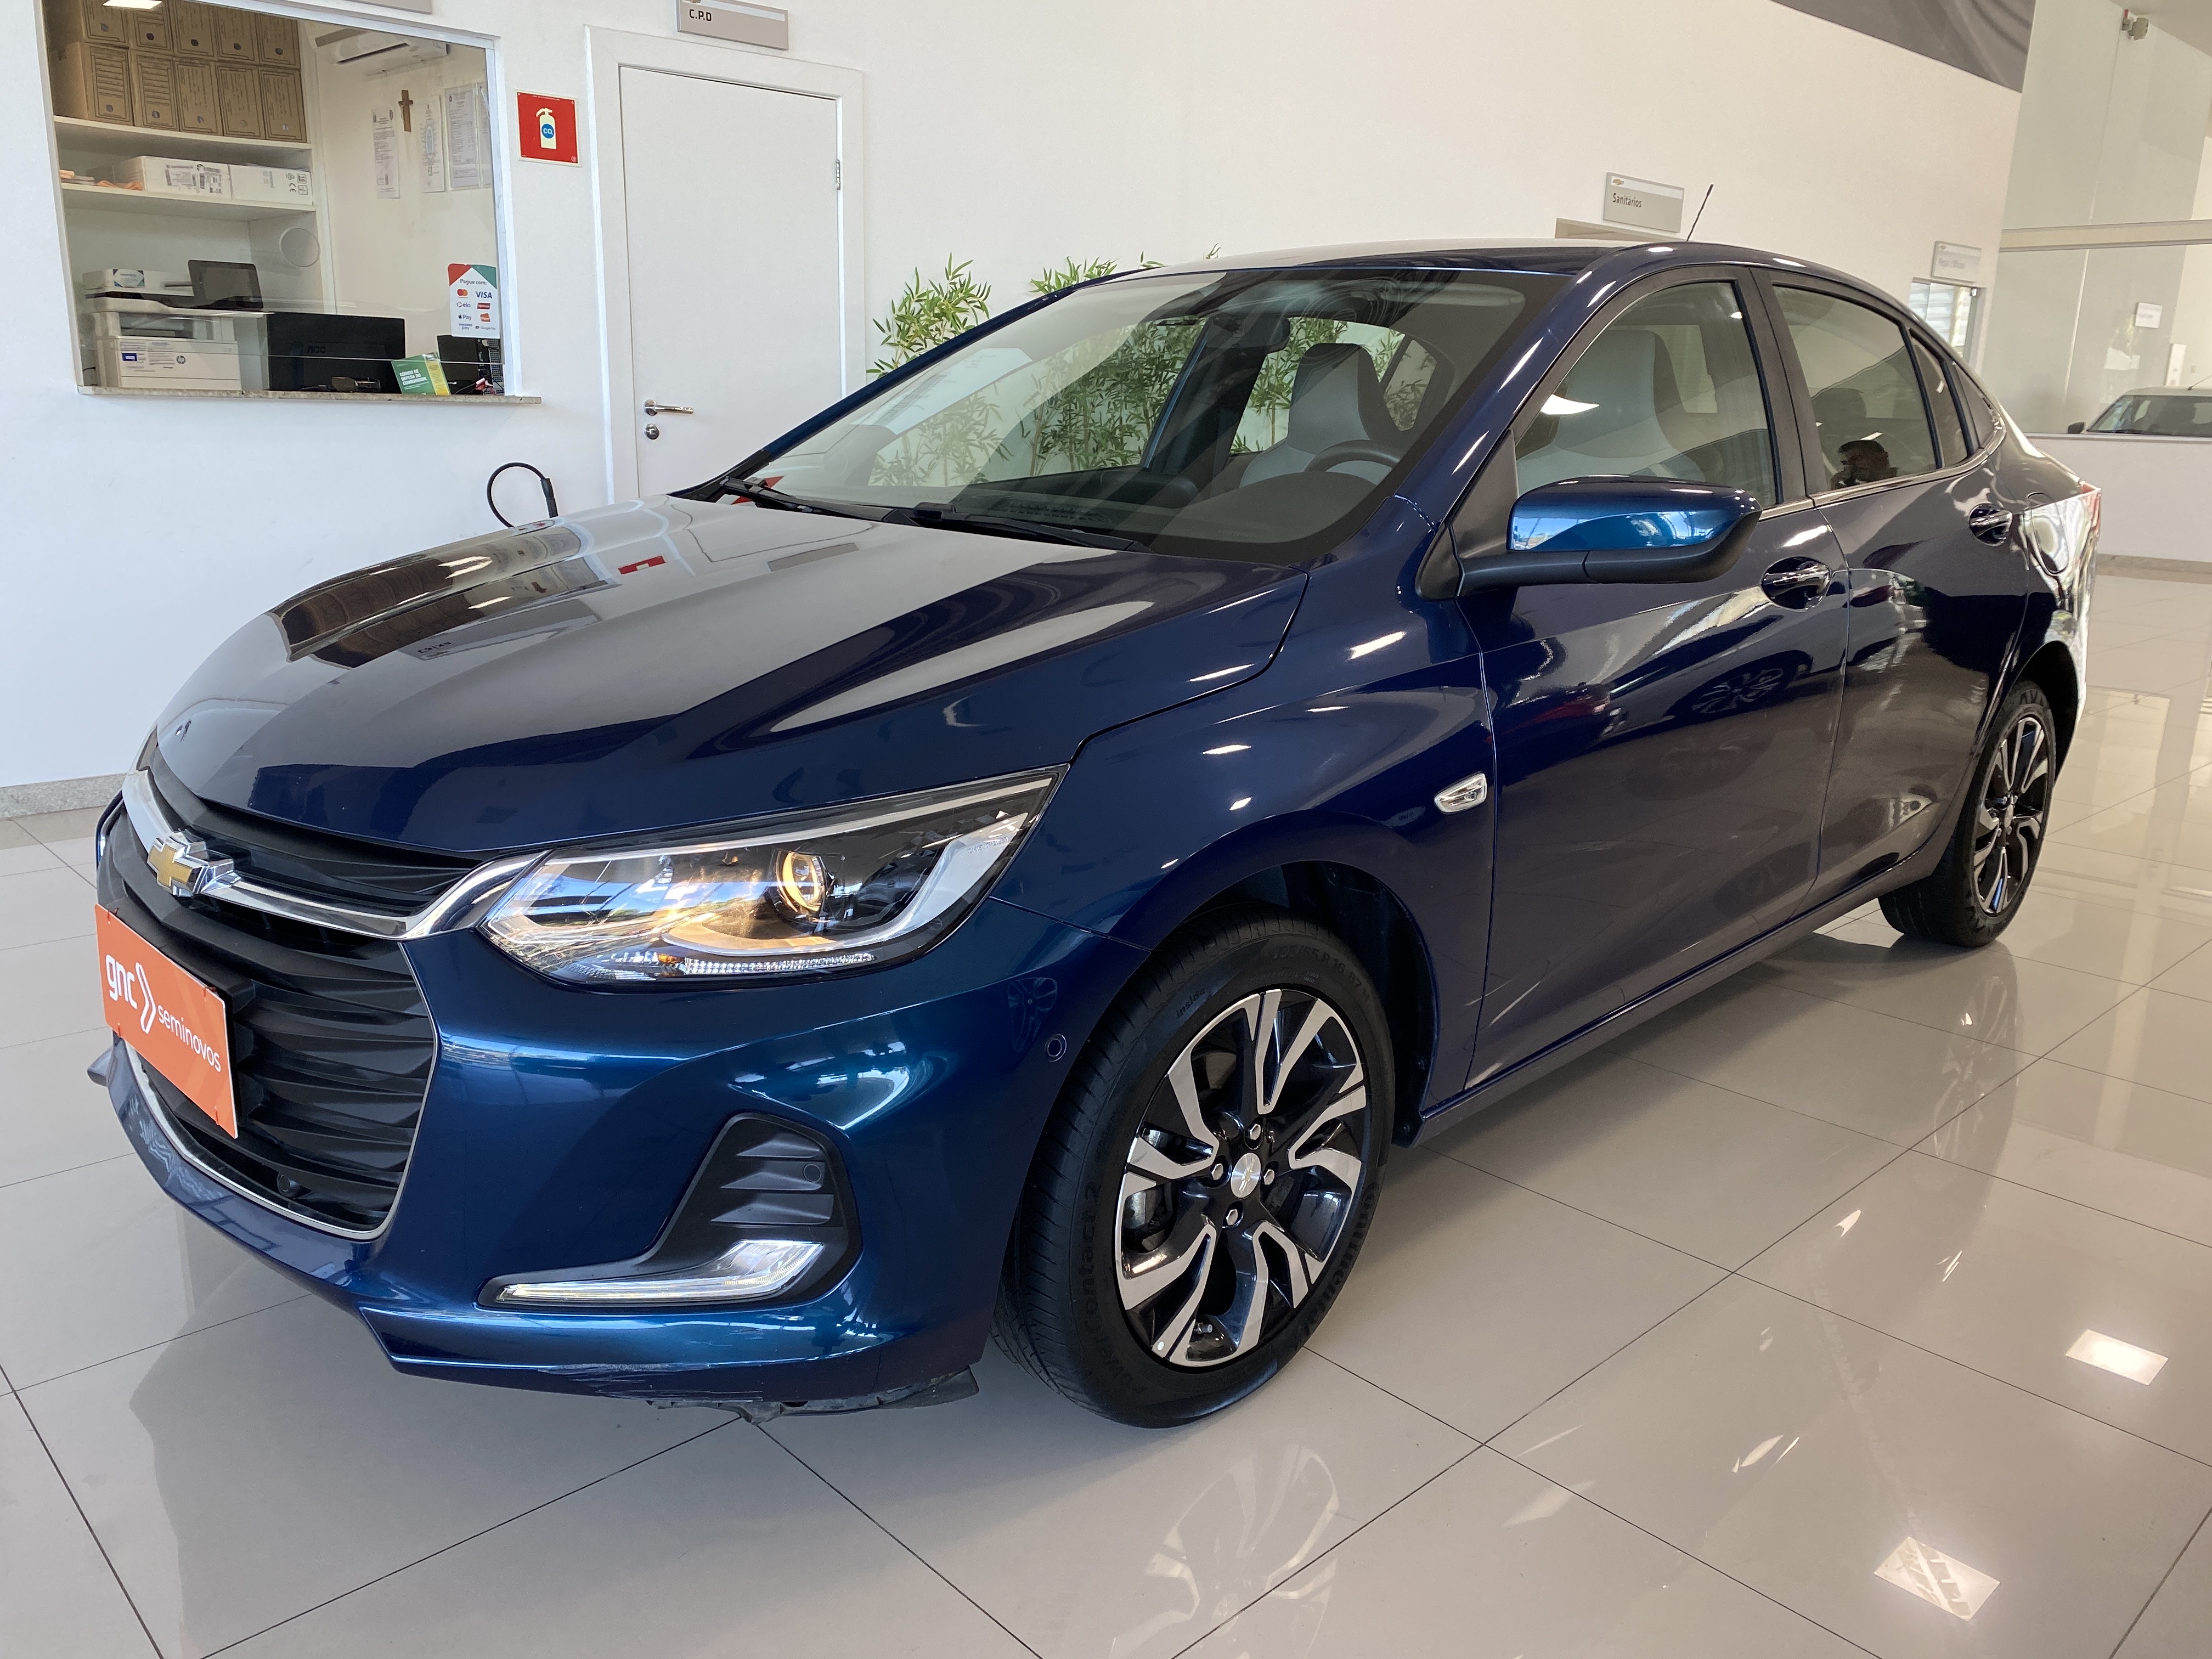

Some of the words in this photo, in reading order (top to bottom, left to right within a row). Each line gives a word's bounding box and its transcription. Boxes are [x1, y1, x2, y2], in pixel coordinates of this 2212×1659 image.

[689, 9, 712, 21] C.P.D
[1612, 193, 1642, 208] Sanitários
[475, 291, 493, 299] VISA
[105, 954, 138, 1009] gnc
[157, 1004, 222, 1073] seminovos
